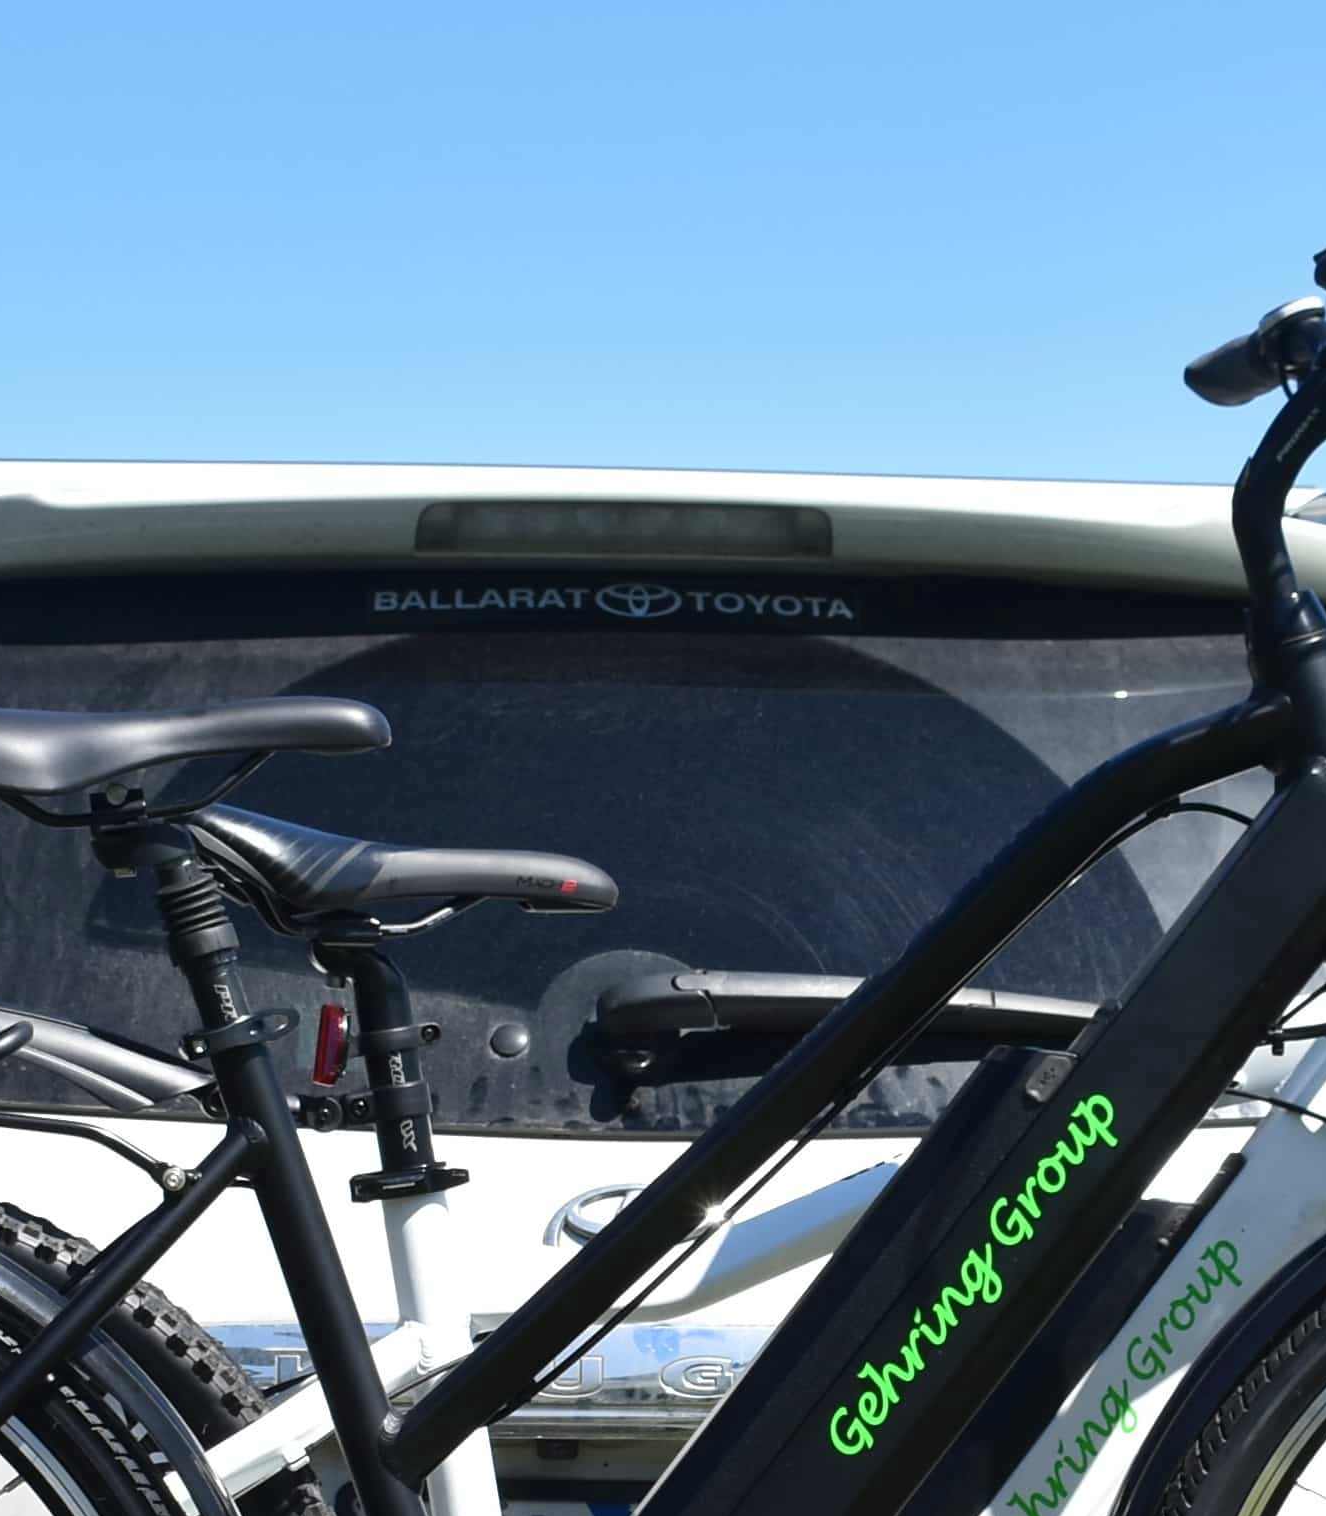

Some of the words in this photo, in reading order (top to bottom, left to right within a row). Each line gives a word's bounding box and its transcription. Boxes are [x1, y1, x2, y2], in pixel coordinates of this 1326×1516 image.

[373, 587, 588, 612] BALLARAT
[690, 591, 855, 619] TOYOTA
[829, 1242, 1003, 1456] Gehring
[990, 1093, 1119, 1246] Group
[1126, 1239, 1243, 1383] Group
